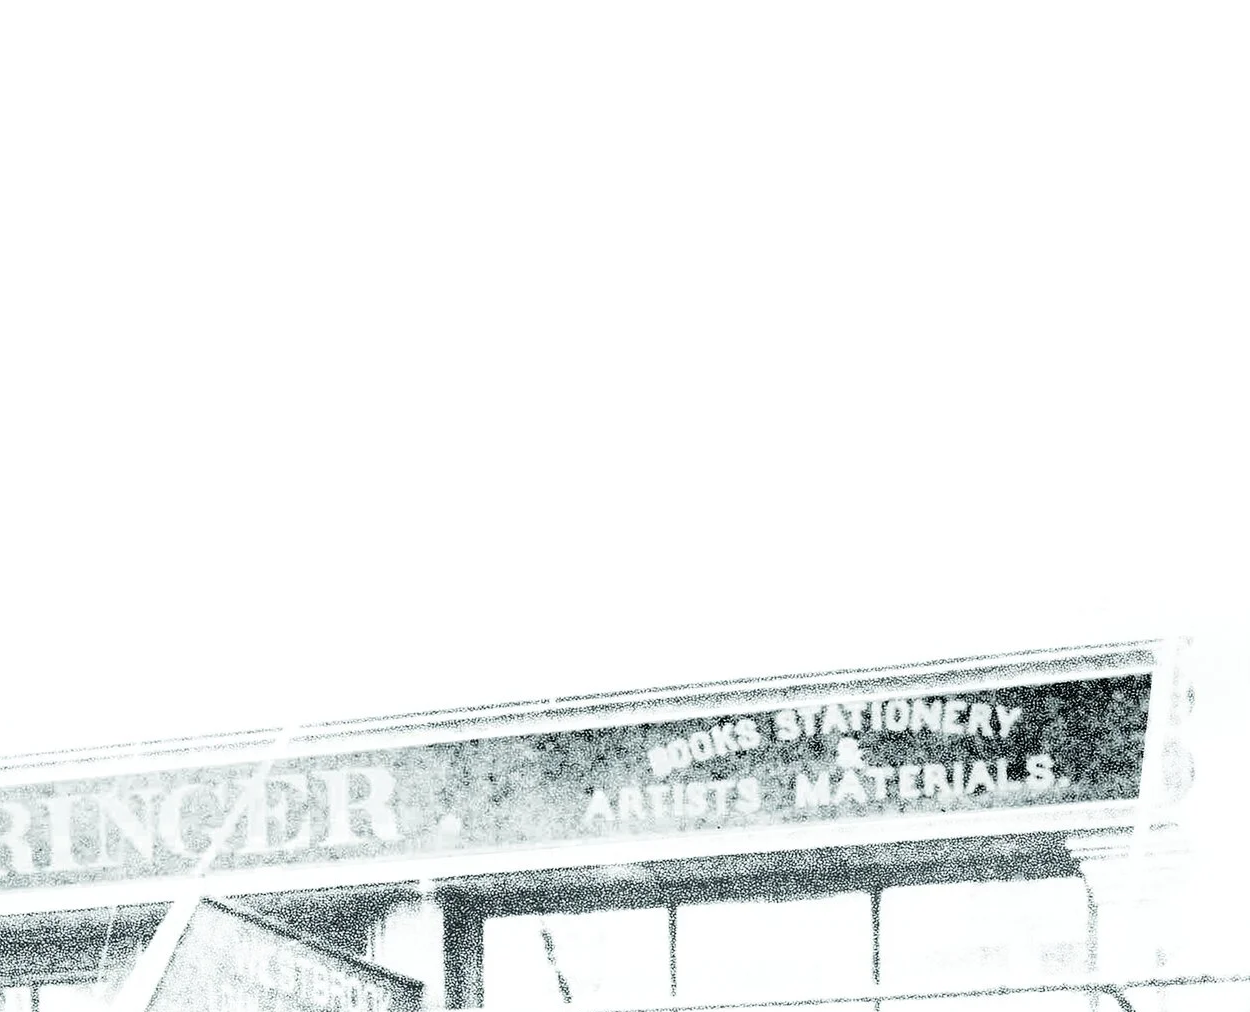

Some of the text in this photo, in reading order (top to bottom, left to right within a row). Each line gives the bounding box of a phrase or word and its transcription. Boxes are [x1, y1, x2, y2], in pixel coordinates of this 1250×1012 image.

[648, 698, 1021, 777] BOOKS STATIONERY
[583, 776, 762, 822] ARTISTS
